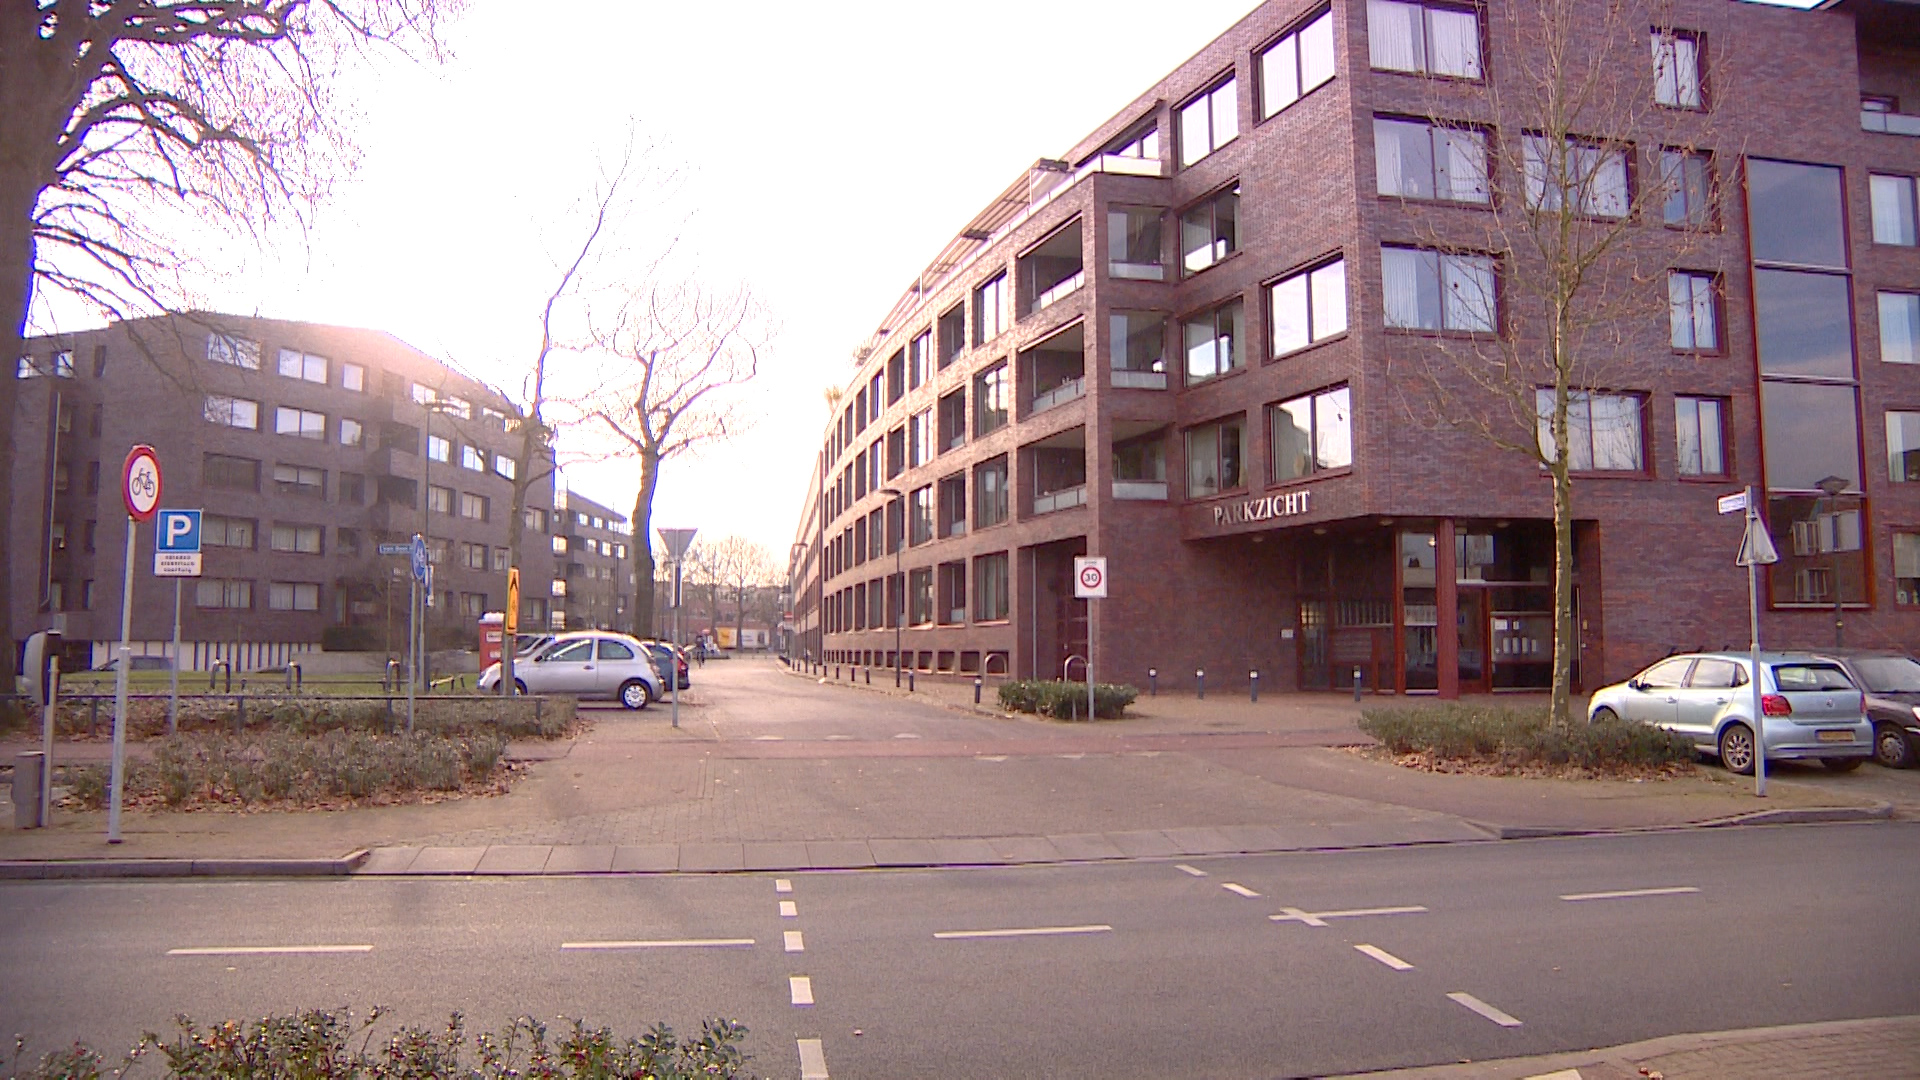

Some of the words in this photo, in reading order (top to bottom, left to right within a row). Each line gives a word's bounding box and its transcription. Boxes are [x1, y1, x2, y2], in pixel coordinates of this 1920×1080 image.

[1213, 489, 1310, 525] PARKZICHT
[166, 515, 192, 547] P
[1084, 573, 1098, 582] 30
